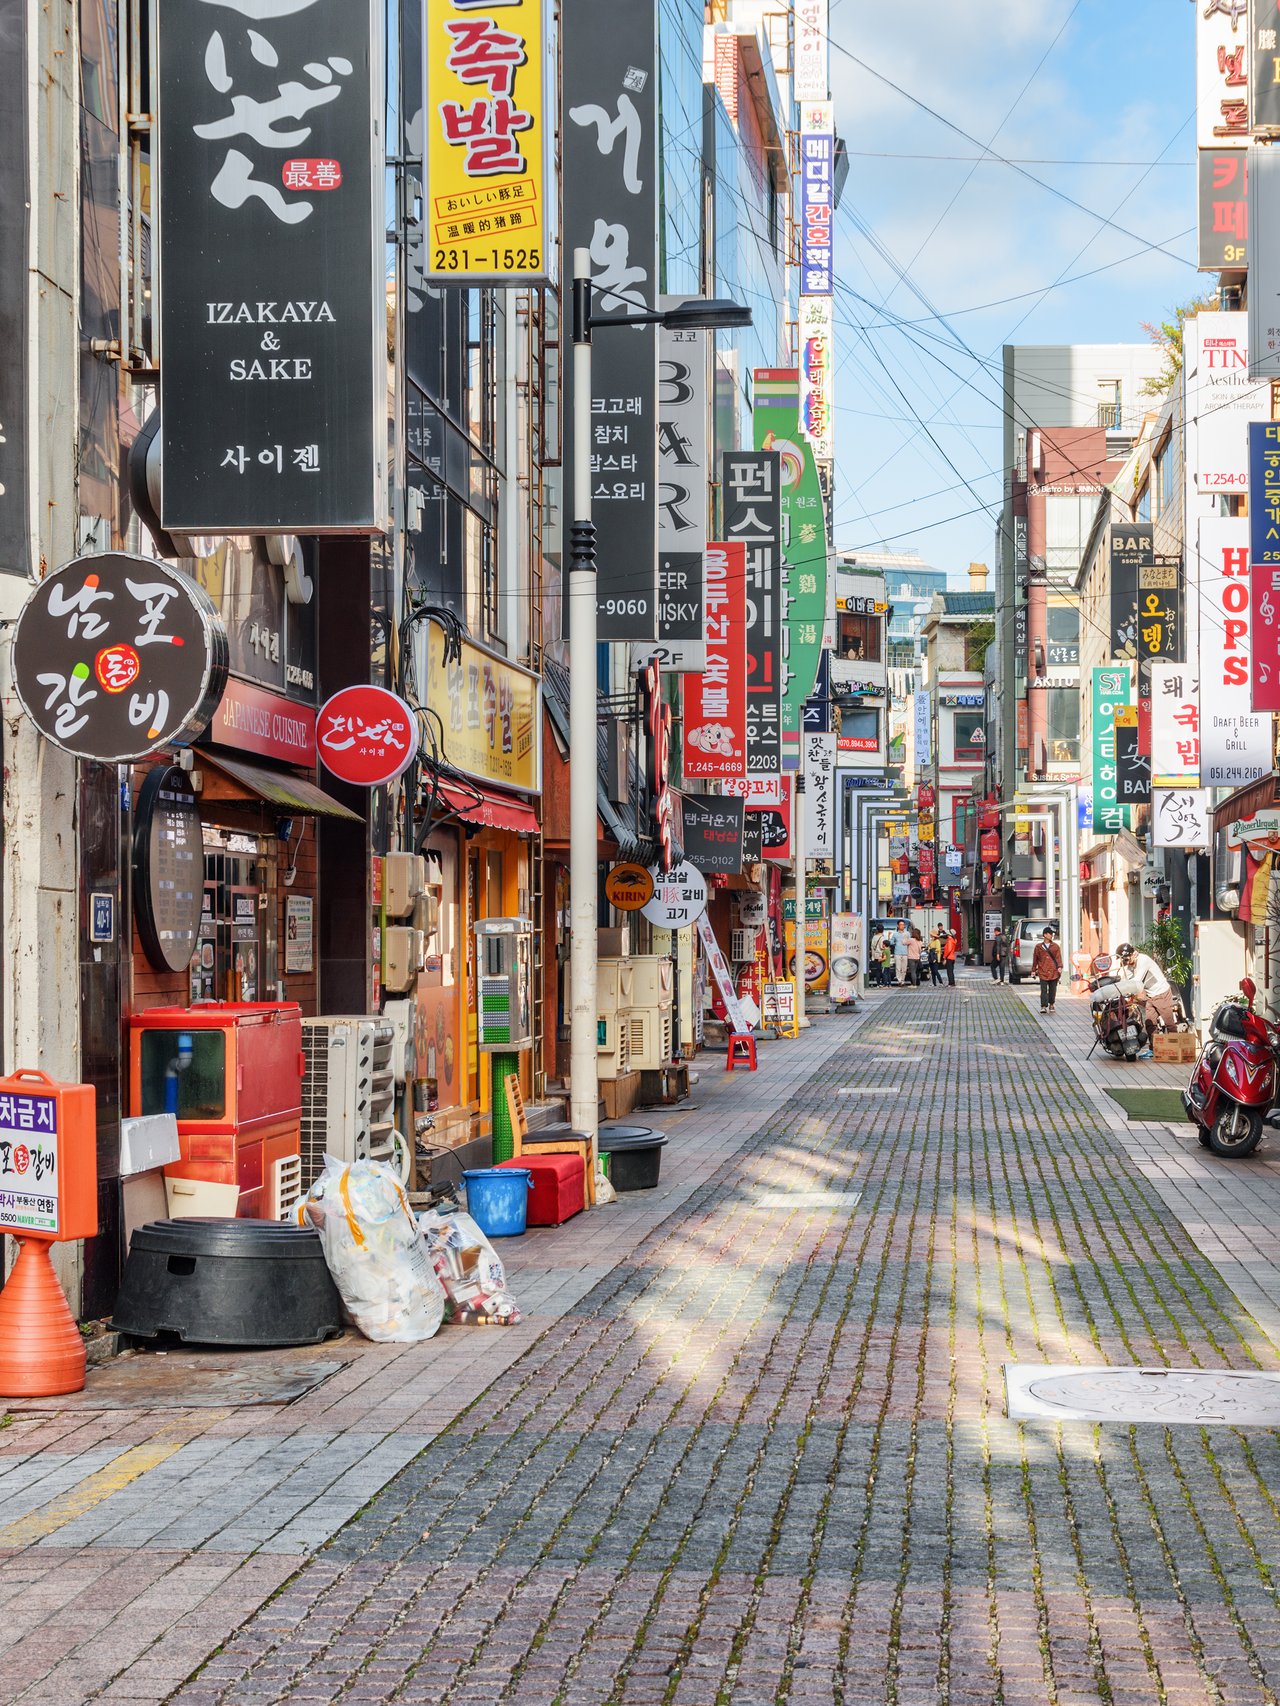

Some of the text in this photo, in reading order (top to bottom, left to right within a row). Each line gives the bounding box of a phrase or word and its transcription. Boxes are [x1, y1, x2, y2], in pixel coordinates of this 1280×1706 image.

[439, 17, 535, 177] 족발
[194, 0, 353, 224] いぜん
[284, 160, 342, 189] 最善
[446, 185, 526, 212] おいしい豚足
[435, 249, 541, 271] 231-1525
[1224, 245, 1246, 262] 3F
[206, 301, 337, 325] IZAKAYA
[259, 330, 281, 351] &
[671, 331, 697, 343] 코코
[1202, 349, 1248, 368] TIN
[229, 358, 313, 381] SAKE
[590, 397, 642, 415] 크고래
[594, 424, 629, 444] 참치
[220, 444, 322, 473] 사이젠
[591, 482, 645, 501] 스요리
[1112, 538, 1151, 551] BAR
[659, 572, 688, 590] EER
[596, 600, 647, 615] -9060
[658, 603, 698, 621] HISKY
[1141, 593, 1165, 653] 오뎅
[1222, 548, 1250, 686] HOPS
[1164, 606, 1176, 652] おでん
[653, 648, 684, 666] 2F
[36, 662, 170, 739] 갈비
[747, 704, 777, 722] 스트
[223, 698, 307, 749] JAPANESE CUISINE
[1173, 704, 1200, 766] 국밥
[359, 747, 385, 756] 사이젠
[1225, 739, 1247, 751] GRILL
[688, 762, 742, 772] T.245-4669
[749, 756, 777, 769] .2203
[738, 780, 779, 799] 양꼬치
[743, 830, 759, 838] TAY
[688, 853, 735, 865] 255-0102
[655, 872, 689, 884] 삼겹살
[612, 890, 647, 902] KIRIN
[681, 888, 704, 901] 갈비
[666, 907, 688, 920] 고기
[785, 901, 822, 914] 서계탕
[0, 1096, 54, 1132] 차금지
[37, 1198, 55, 1214] 연합
[0, 1212, 35, 1226] 5500 NAVER
